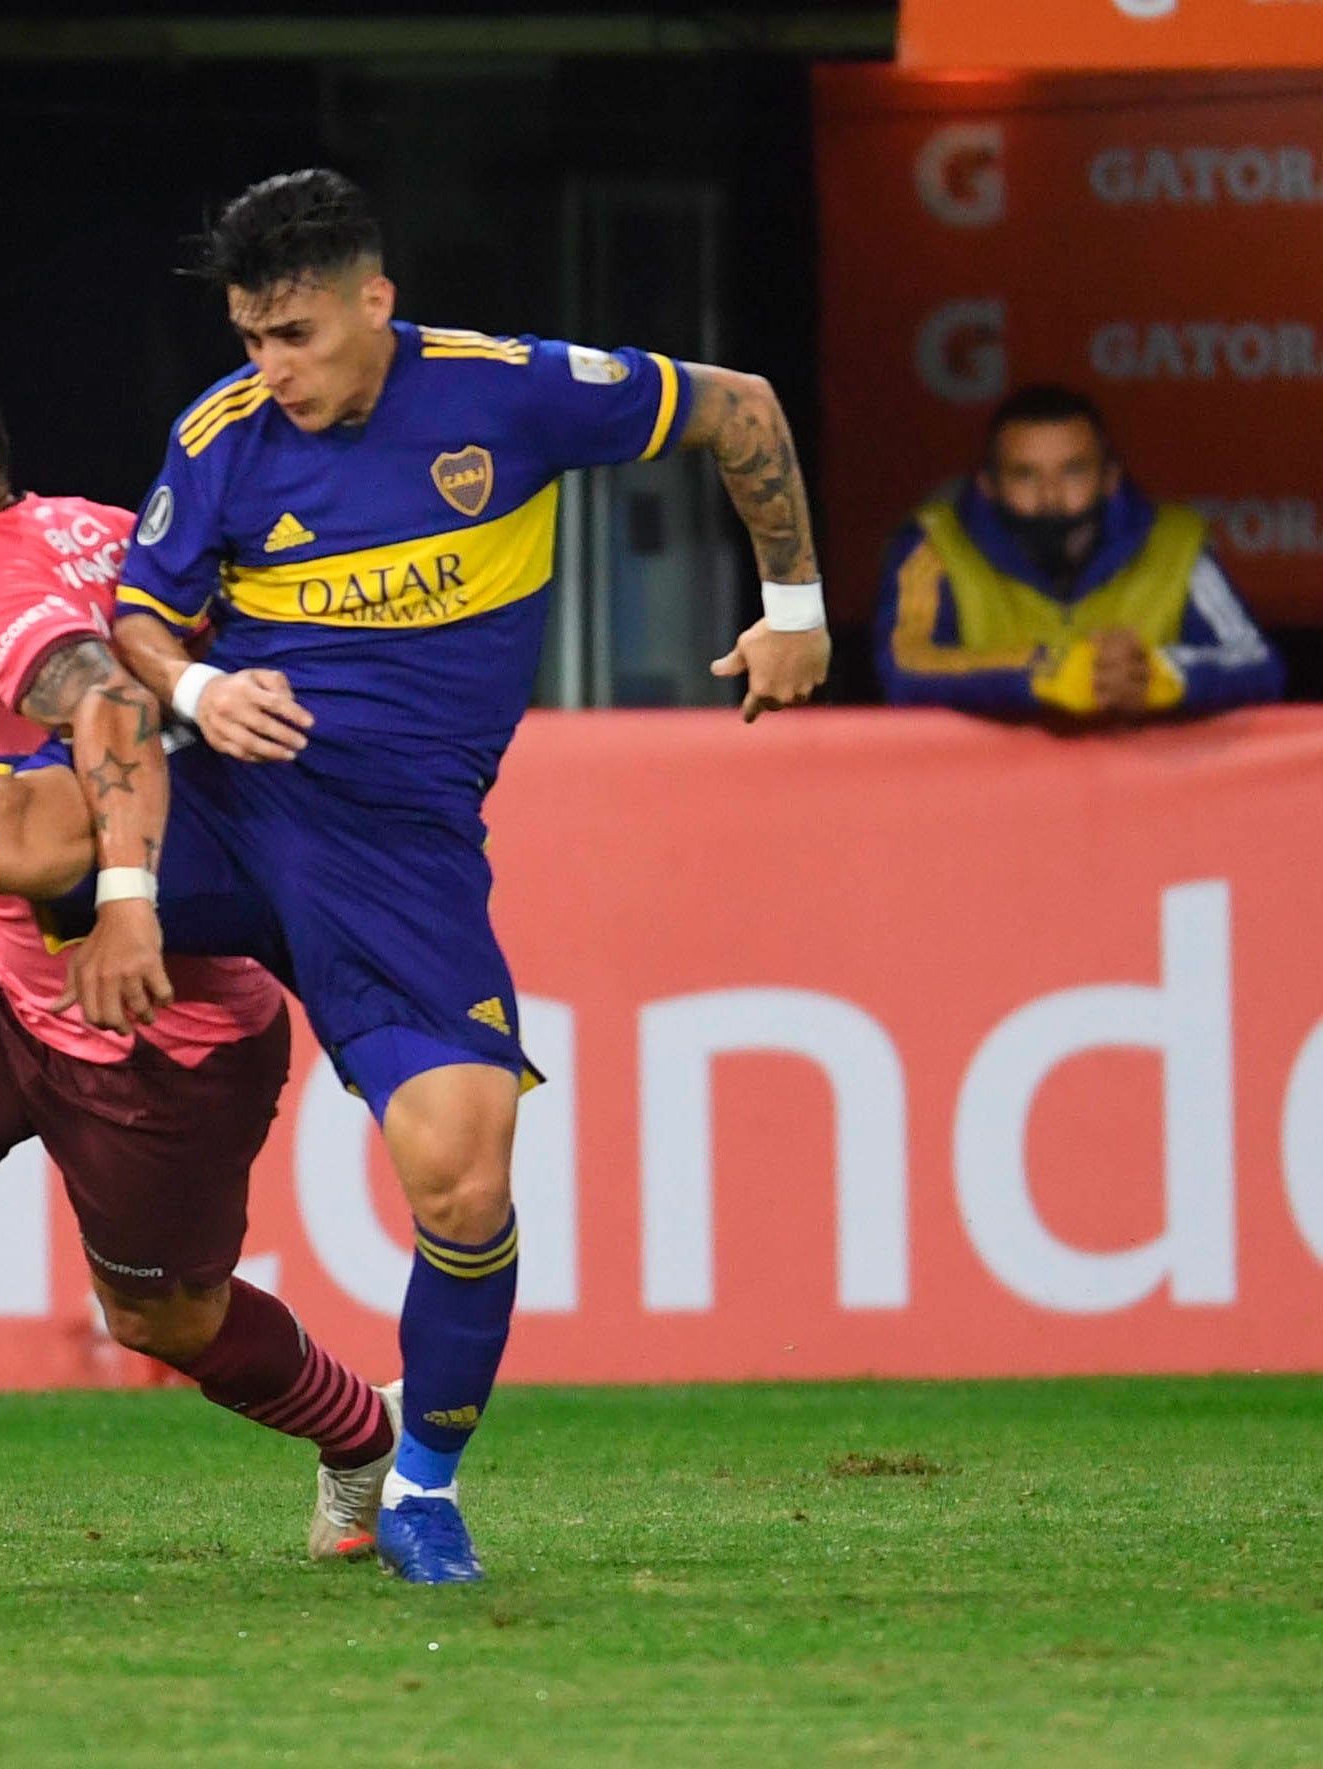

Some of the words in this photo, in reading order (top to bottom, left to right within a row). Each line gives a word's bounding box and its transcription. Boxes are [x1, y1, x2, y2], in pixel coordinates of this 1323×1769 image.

[916, 124, 1005, 225] G
[1089, 147, 1323, 204] GATOR
[916, 302, 1005, 402] G
[1089, 321, 1323, 378] GATOR
[298, 553, 465, 617] QATAR
[339, 590, 469, 623] AIRWAYS
